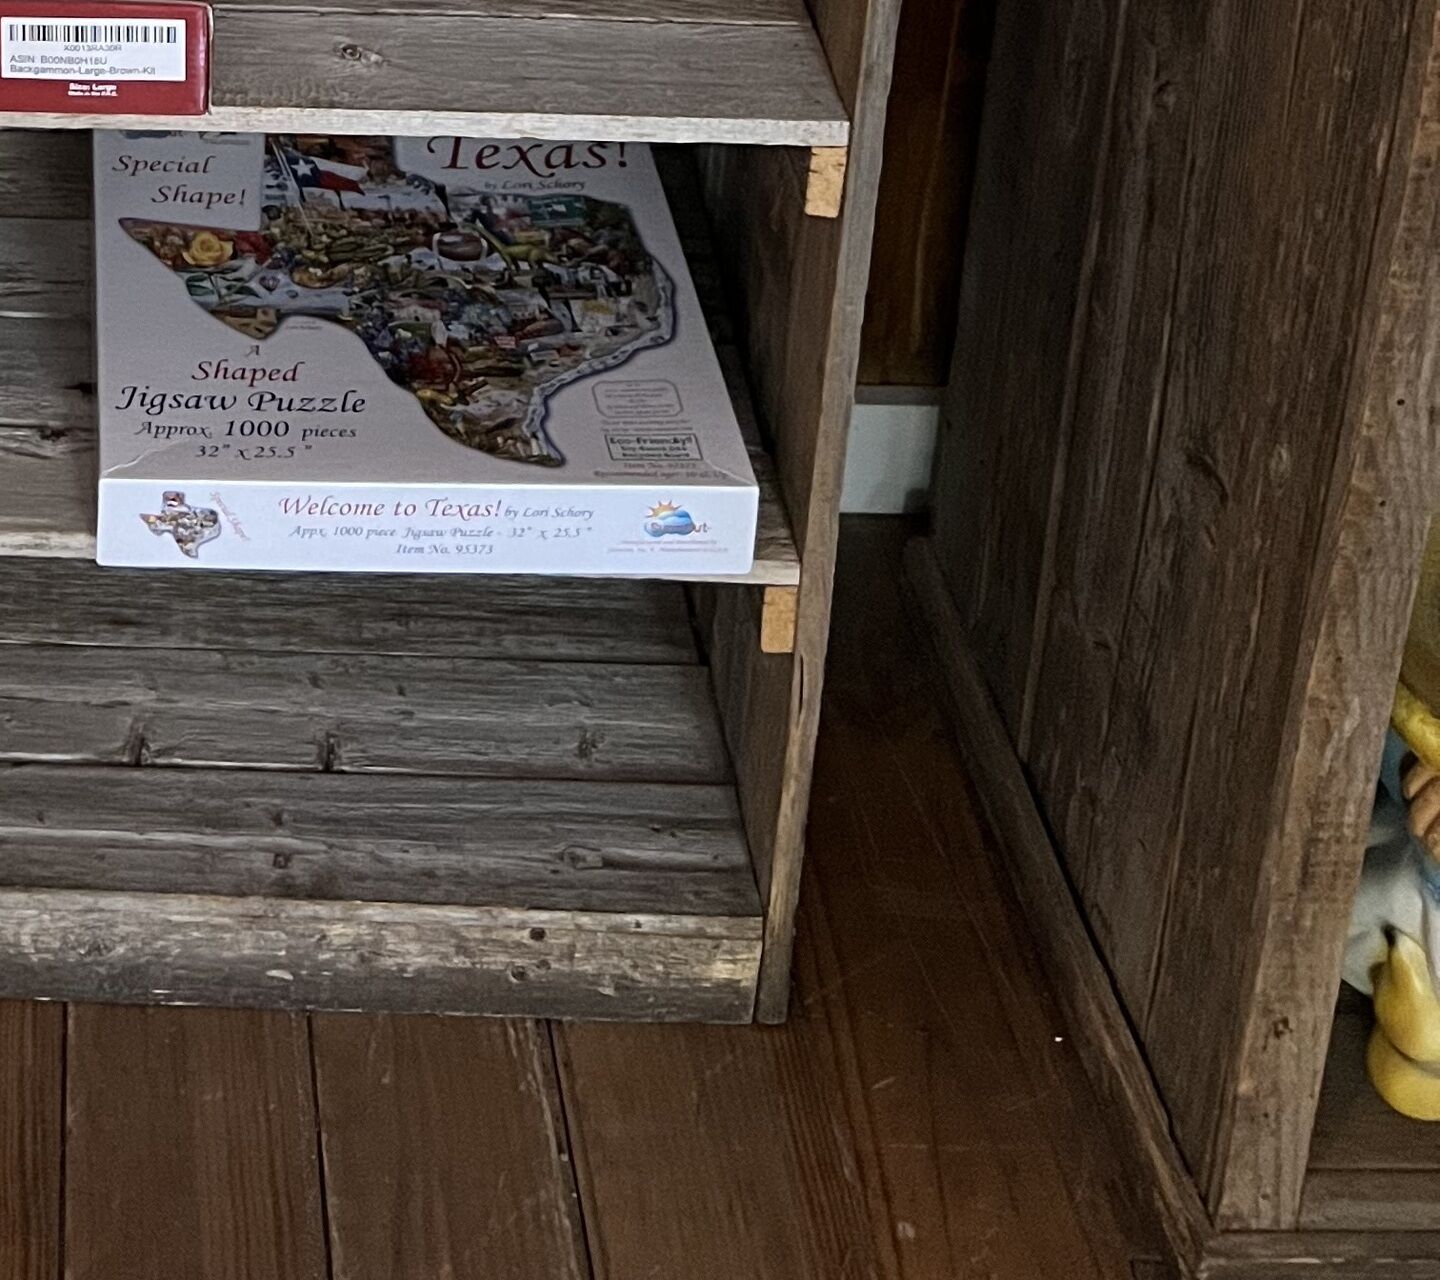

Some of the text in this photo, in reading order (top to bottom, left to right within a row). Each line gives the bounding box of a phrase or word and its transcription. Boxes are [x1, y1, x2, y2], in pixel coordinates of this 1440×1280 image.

[112, 155, 216, 177] Special
[426, 136, 628, 178] Texas!
[151, 183, 247, 210] Shape!
[484, 182, 497, 190] by
[245, 344, 260, 356] A
[191, 359, 306, 387] Shaped
[115, 385, 366, 416] Jigsaw Puzzle
[225, 420, 290, 437] 1000
[301, 427, 357, 441] pieces
[238, 448, 251, 460] x
[278, 495, 594, 521] Welcome to Texas! by Lori Schory
[332, 526, 363, 537] 1000
[365, 526, 397, 539] piece
[402, 526, 448, 539] Jigsaw
[450, 526, 494, 538] Puzzle
[396, 543, 494, 555] Item No. 95373
